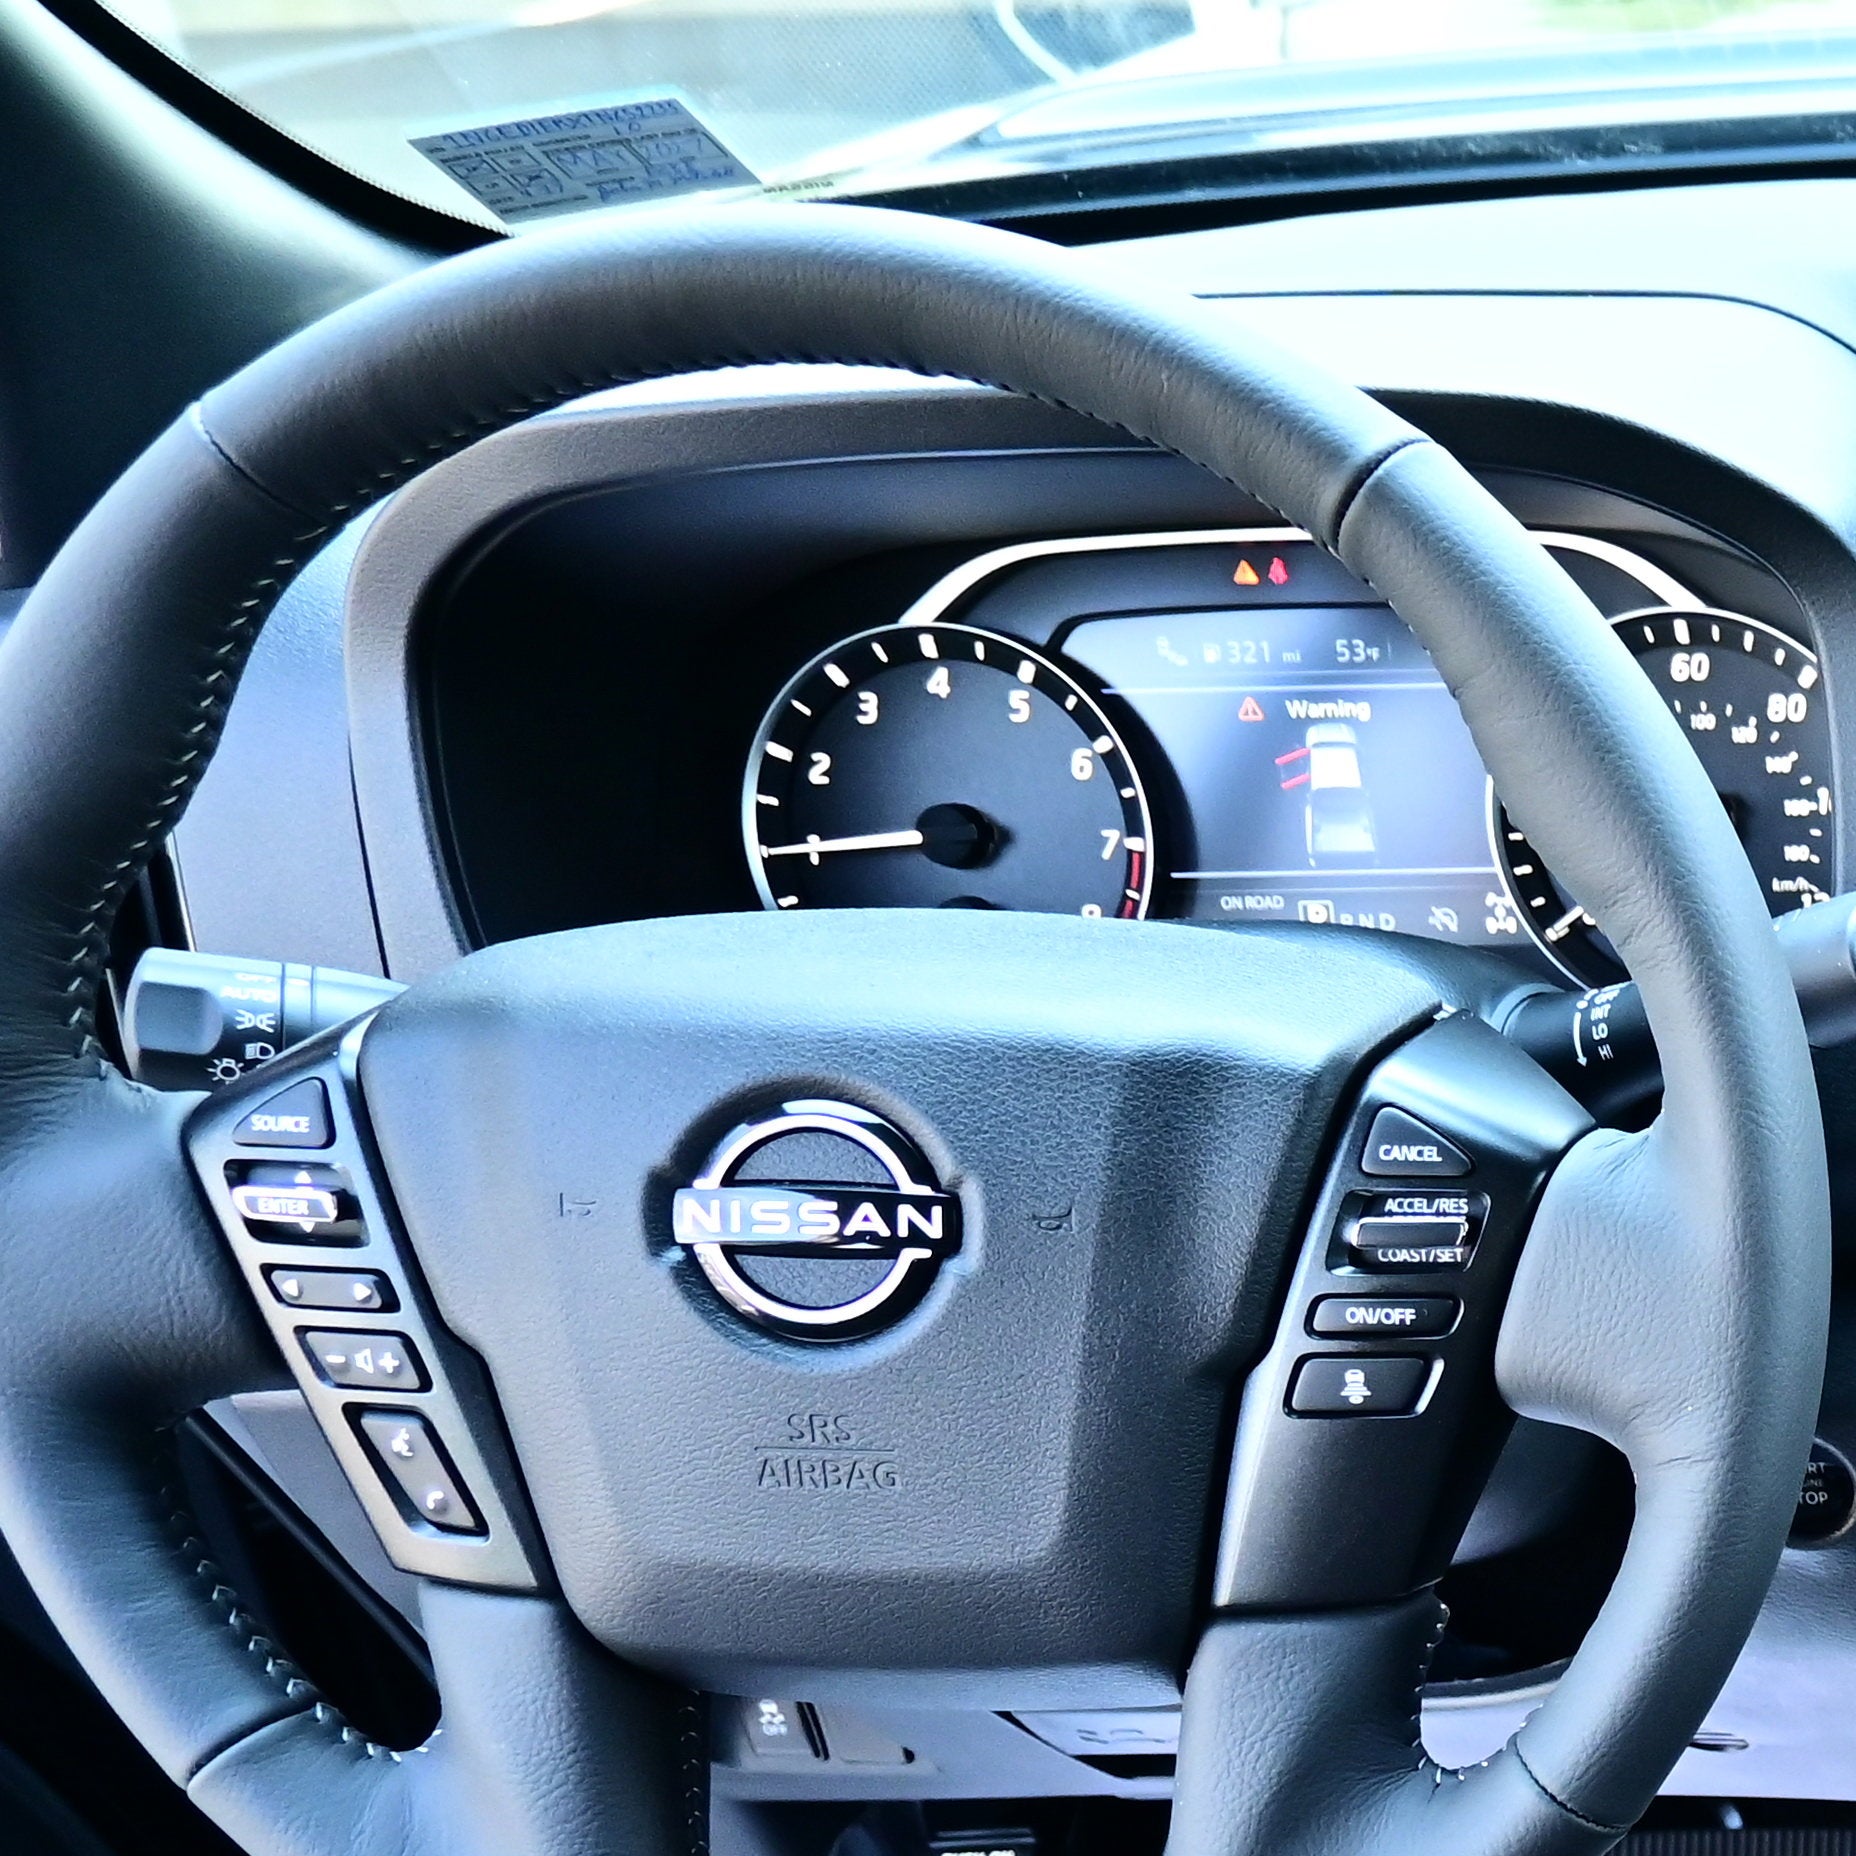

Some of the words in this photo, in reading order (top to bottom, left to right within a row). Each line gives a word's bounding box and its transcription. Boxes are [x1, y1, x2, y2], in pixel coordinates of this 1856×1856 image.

[1226, 640, 1271, 664] 321
[1282, 650, 1302, 663] mi
[1669, 652, 1711, 683] 60
[925, 667, 951, 698] 4
[856, 691, 880, 725] 3
[1008, 691, 1031, 723] 5
[1285, 699, 1371, 722] Warning
[1767, 692, 1808, 723] 80
[1690, 713, 1717, 730] 100
[807, 752, 832, 786] 2
[1070, 749, 1094, 781] 6
[1100, 829, 1120, 861] 7
[1772, 876, 1809, 893] km/h
[1220, 896, 1243, 911] ON
[1244, 895, 1285, 910] ROAD
[1590, 1003, 1612, 1021] INT
[1592, 1023, 1608, 1040] LO
[1597, 1044, 1614, 1060] HI
[250, 1114, 310, 1134] SOURCE
[1378, 1144, 1443, 1163] CANCEL
[256, 1197, 310, 1216] ENTER
[1383, 1196, 1469, 1215] ACCEL/RES
[682, 1199, 944, 1240] NISSAN
[1376, 1247, 1464, 1263] COAST/SET
[1344, 1306, 1417, 1326] ON/OFF
[786, 1414, 851, 1444] SRS
[757, 1455, 898, 1491] AIRBAG
[1799, 1491, 1828, 1504] TOP
